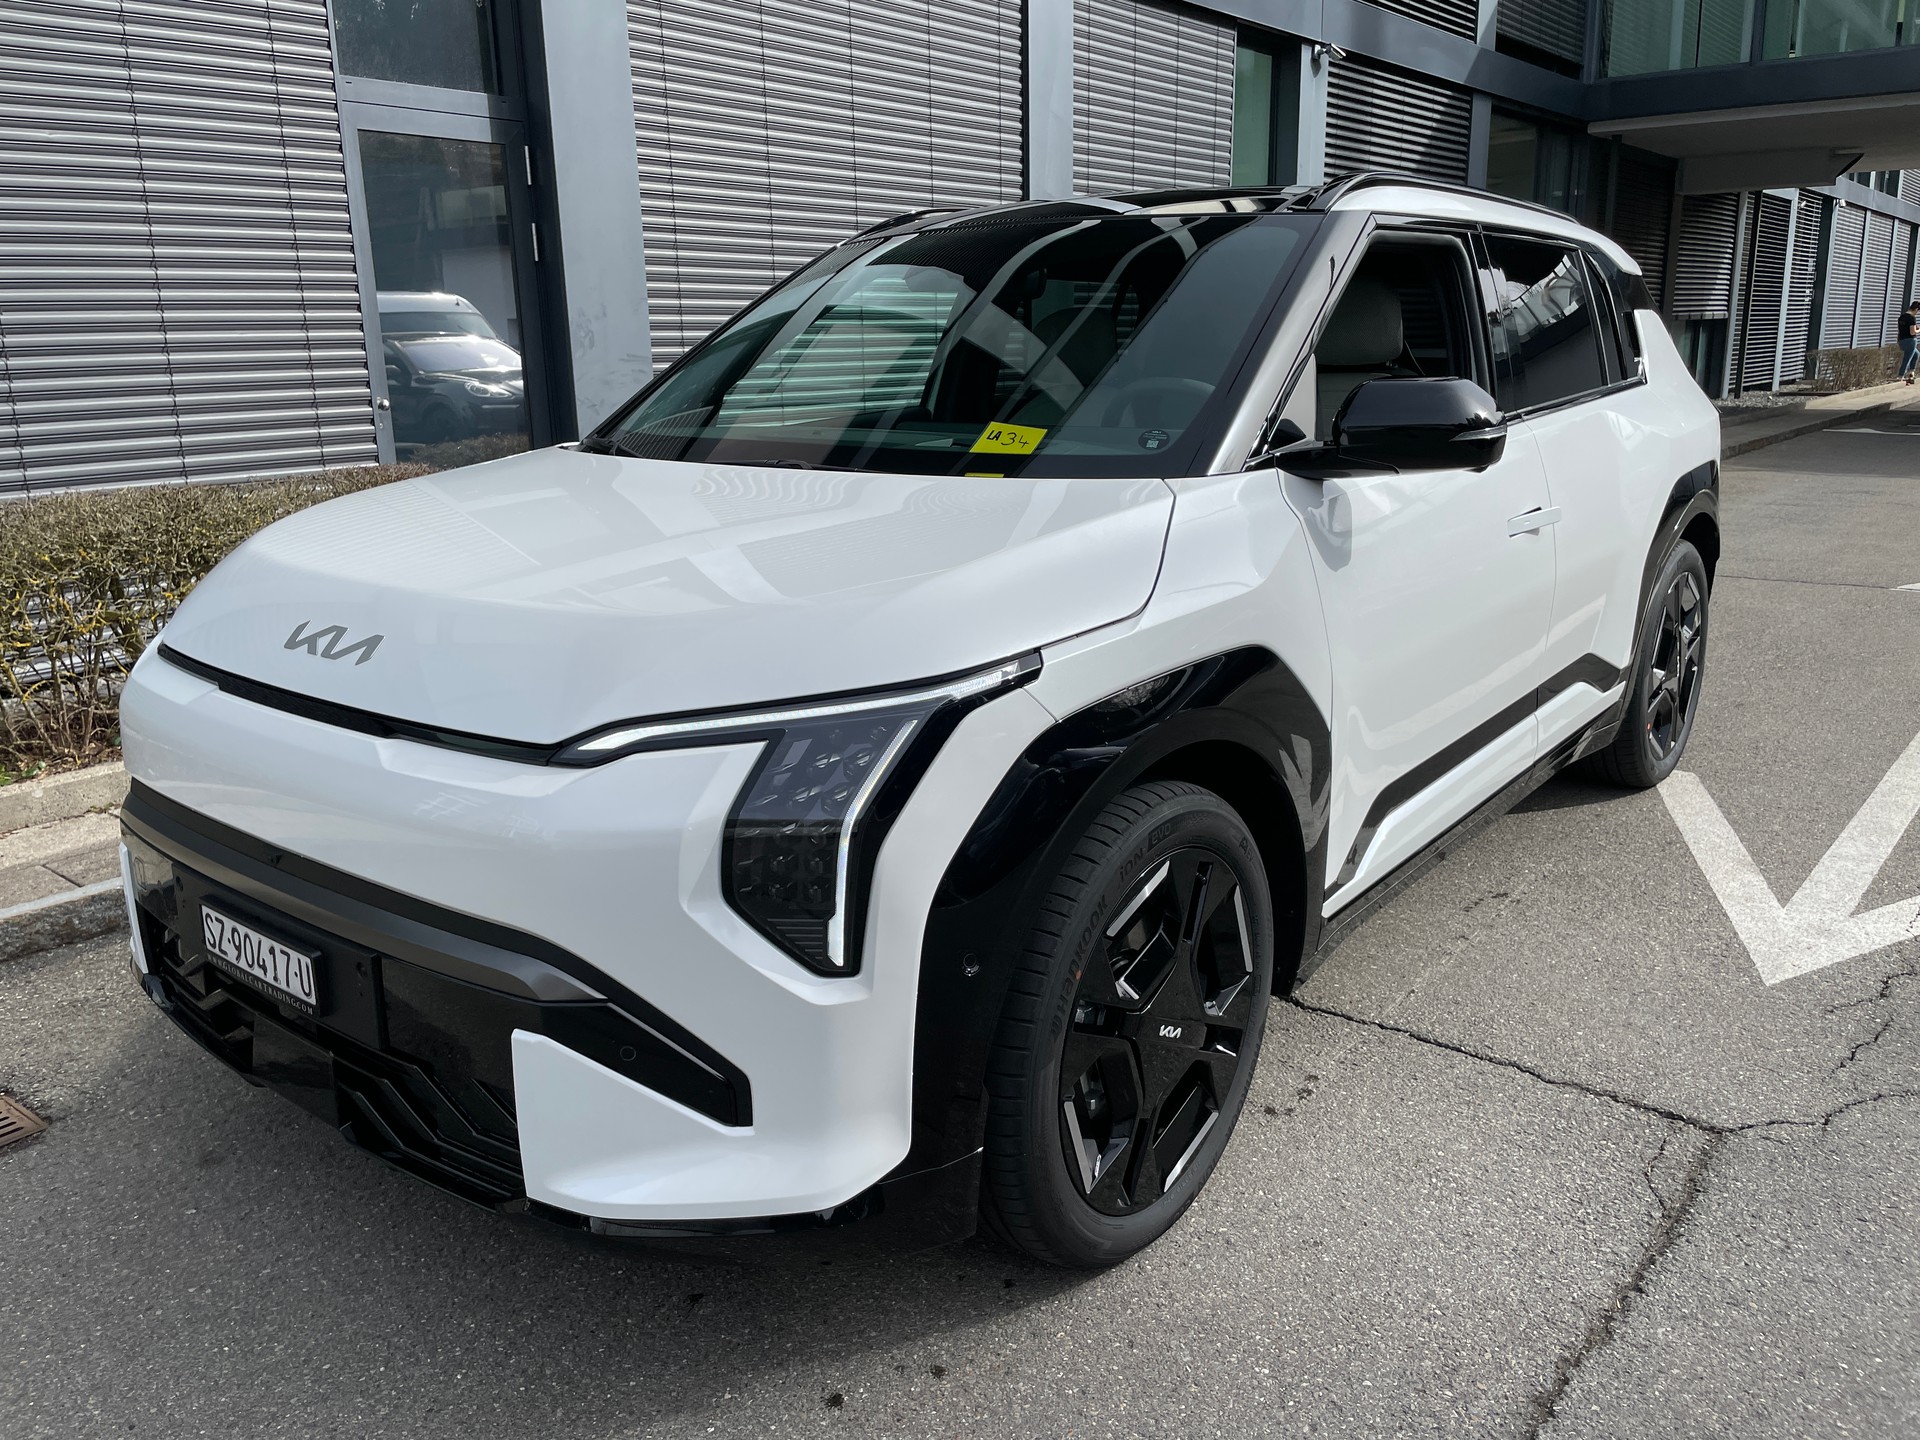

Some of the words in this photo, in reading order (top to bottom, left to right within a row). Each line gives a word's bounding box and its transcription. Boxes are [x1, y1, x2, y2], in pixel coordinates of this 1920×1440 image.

[1001, 432, 1029, 448] 34
[283, 619, 385, 666] KIA
[1159, 1024, 1182, 1039] KIA
